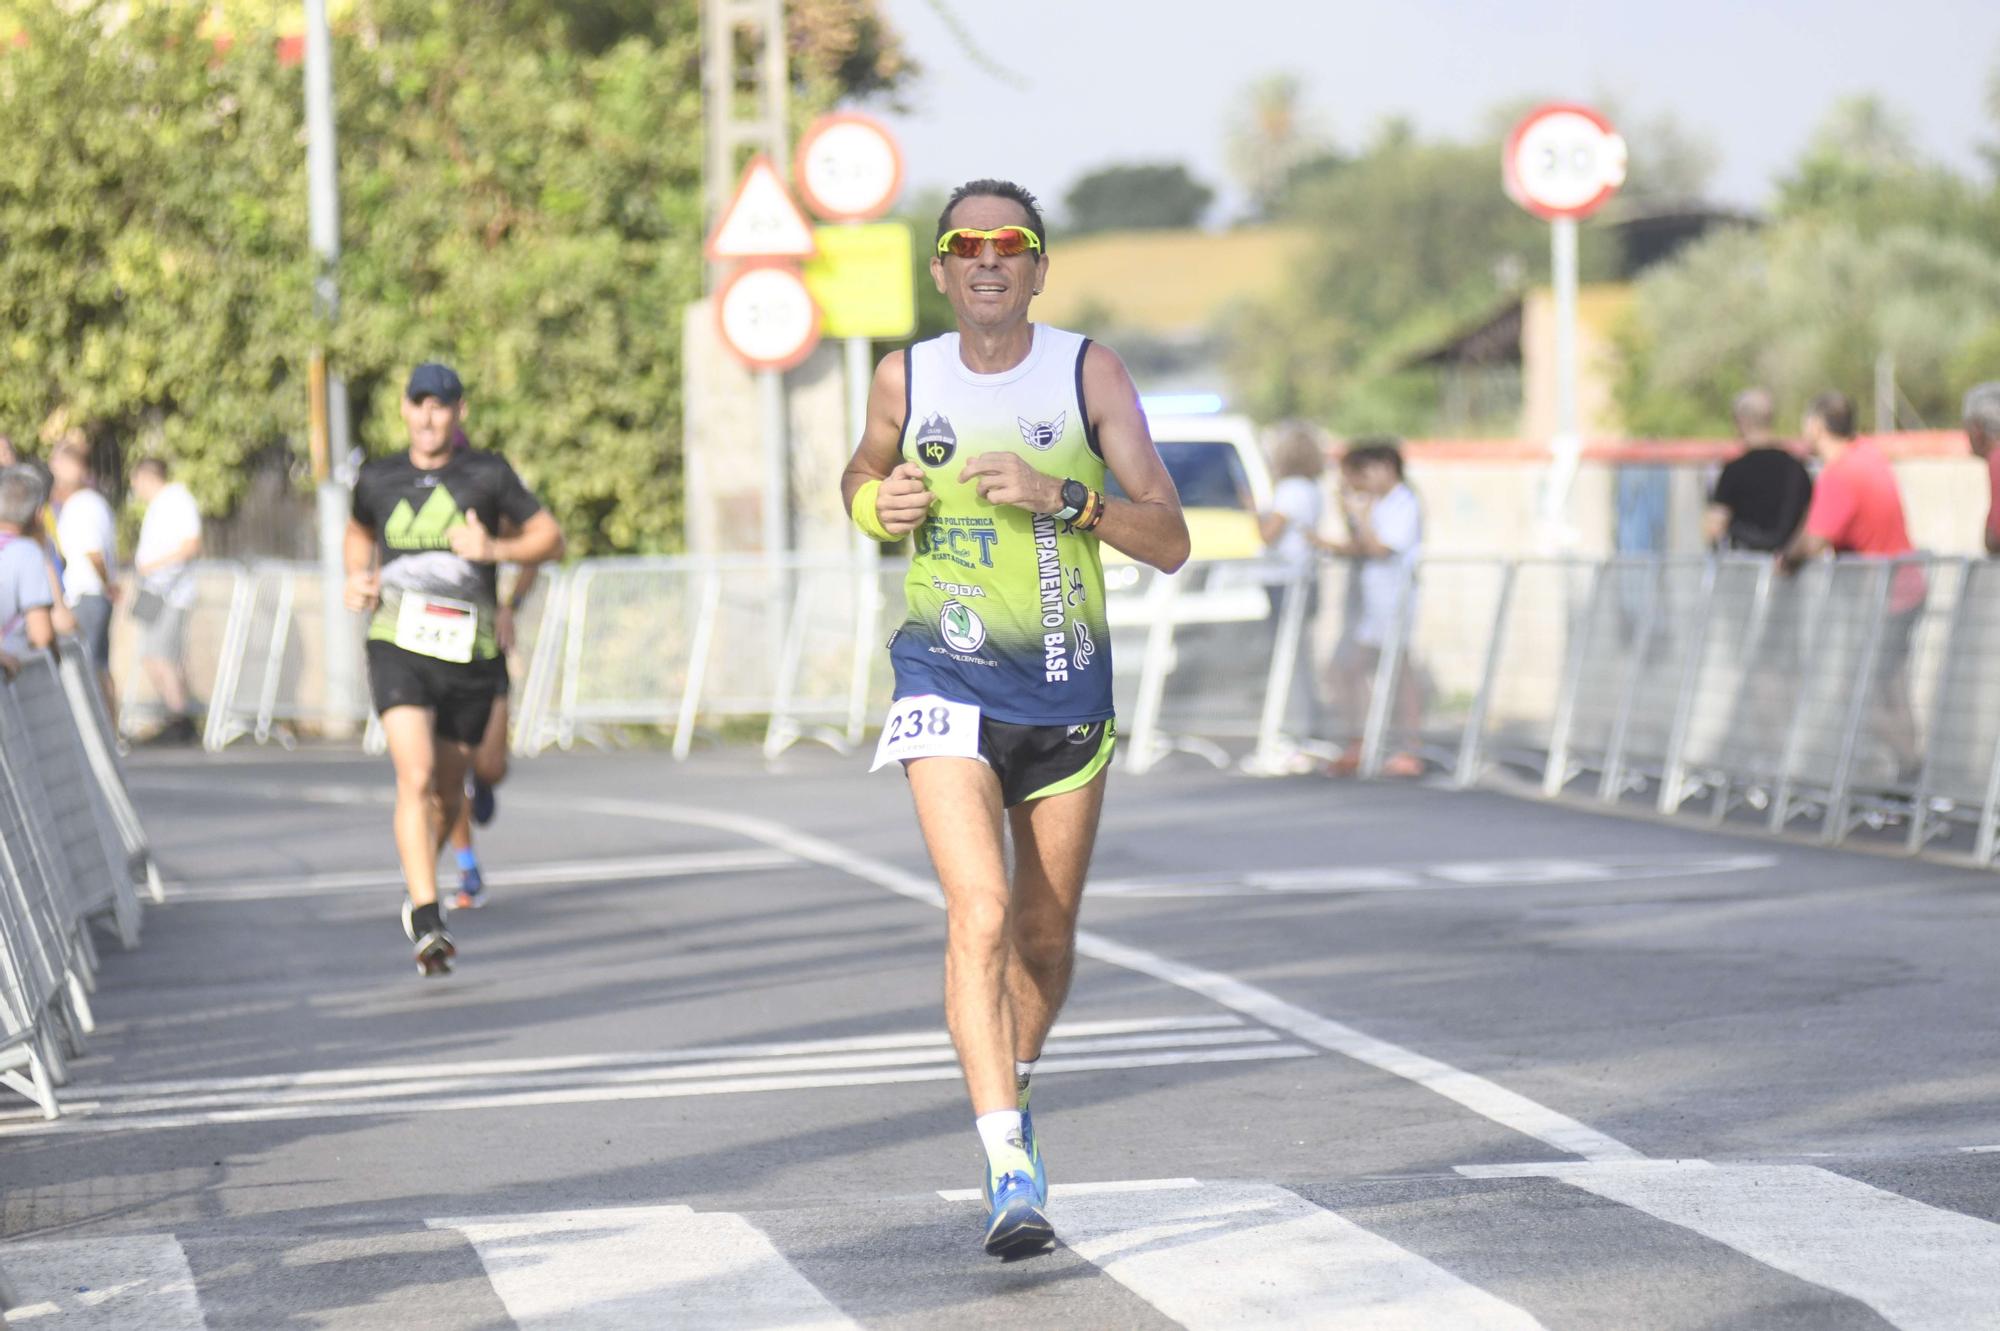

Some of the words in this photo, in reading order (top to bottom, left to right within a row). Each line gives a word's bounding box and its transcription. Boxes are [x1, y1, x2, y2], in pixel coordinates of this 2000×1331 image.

[1031, 511, 1065, 629] AMPAMENTO
[1043, 631, 1069, 683] BASE
[887, 706, 951, 746] 238
